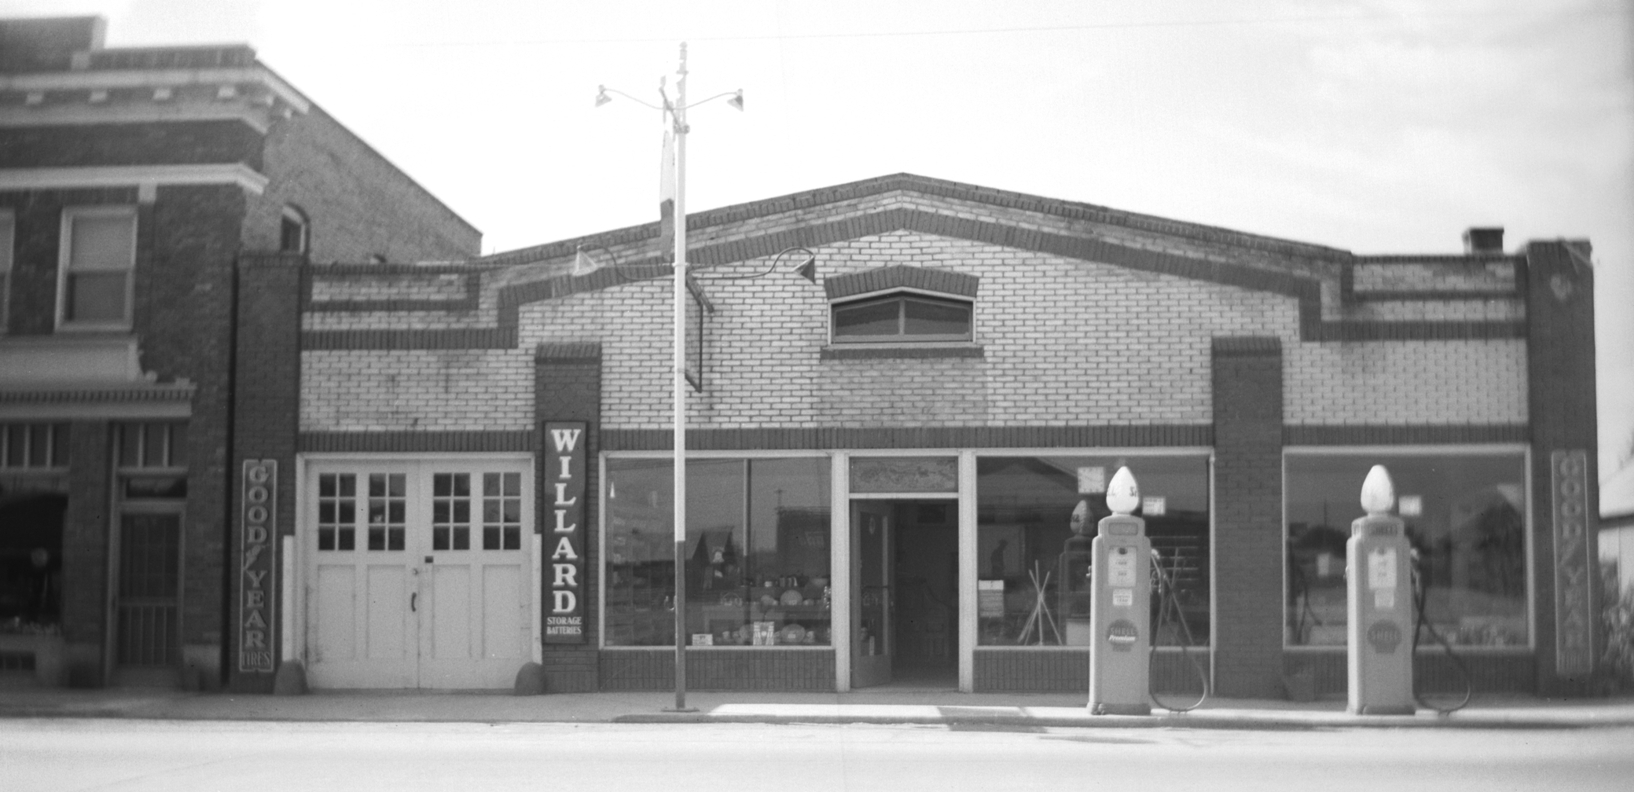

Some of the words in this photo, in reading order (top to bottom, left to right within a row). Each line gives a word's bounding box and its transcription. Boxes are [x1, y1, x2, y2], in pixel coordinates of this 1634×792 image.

[551, 428, 581, 614] WILLARD
[547, 616, 582, 625] STORAGE
[546, 626, 582, 635] BATTERIES
[1110, 627, 1136, 635] SHELL
[1108, 634, 1136, 642] Premium
